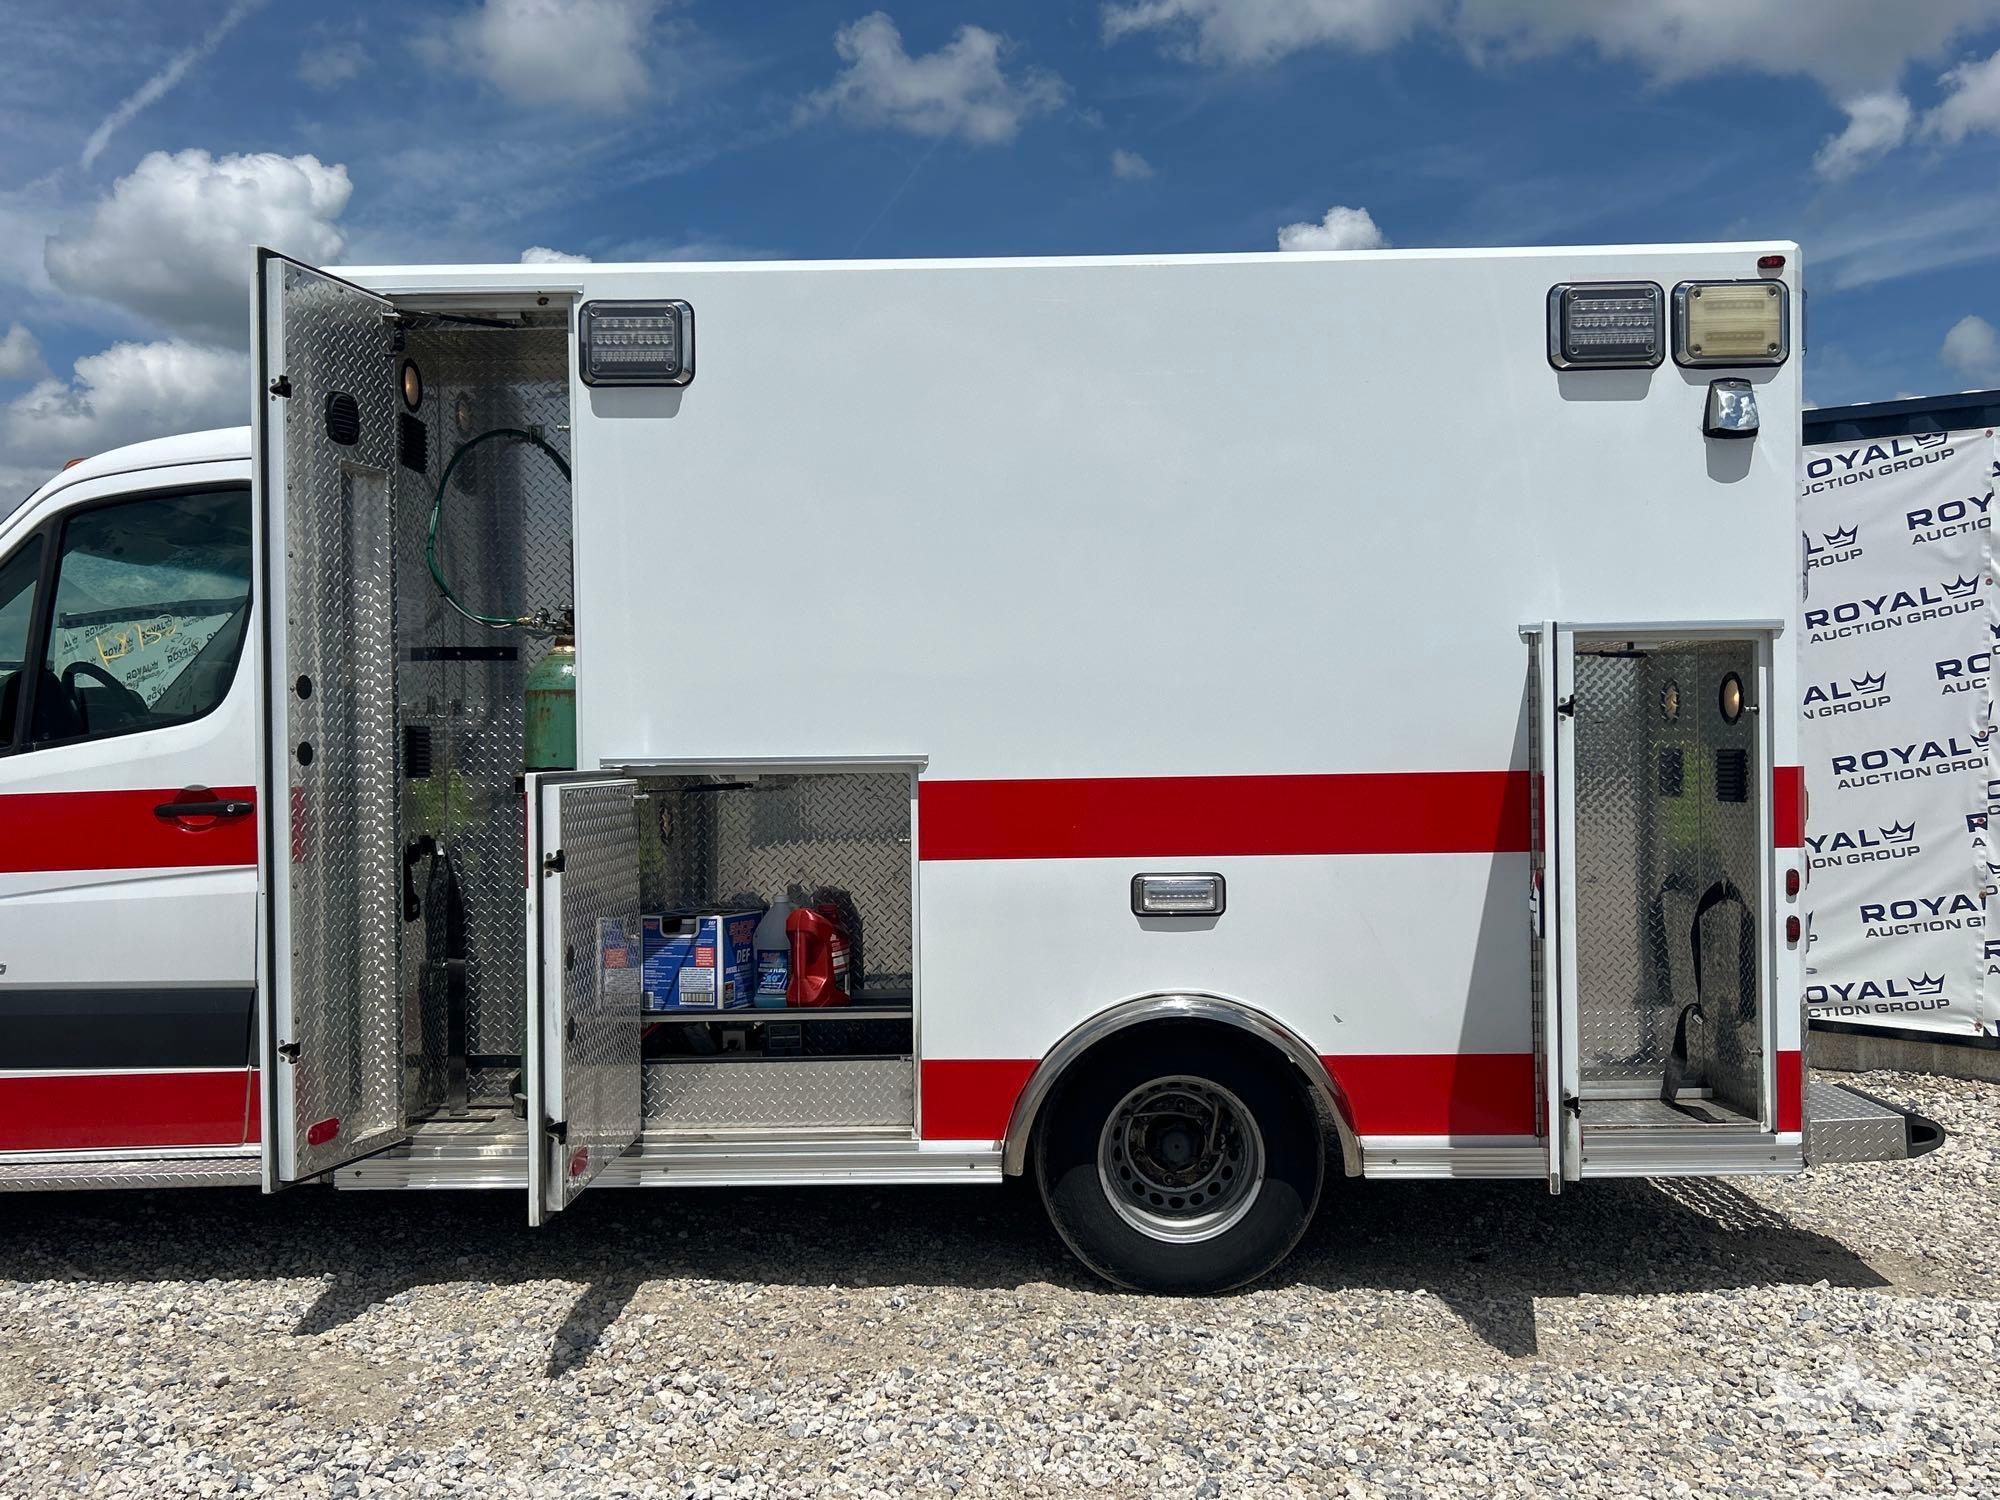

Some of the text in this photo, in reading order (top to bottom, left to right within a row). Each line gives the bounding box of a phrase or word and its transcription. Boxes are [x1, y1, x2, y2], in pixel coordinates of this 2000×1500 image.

[1806, 439, 1914, 479] OYAL
[1802, 448, 1955, 496] UCTION GROUP
[1906, 487, 1995, 531] ROY
[1911, 517, 1992, 545] AUCTIO
[1807, 548, 1864, 570] ROUP
[1804, 587, 1943, 630] ROYAL
[1810, 598, 1985, 644] AUCTION GROUP
[126, 663, 152, 680] ROYAL
[1818, 695, 1892, 718] GROUP
[1831, 737, 1972, 775] ROYAL
[1837, 757, 1989, 790] AUCTION GRO
[1804, 829, 1880, 854] YAL
[1846, 845, 1921, 865] GROUP
[1864, 918, 1962, 939] AUCTION
[736, 948, 751, 964] DEF
[1806, 979, 1910, 1004] OYAL
[1808, 998, 1951, 1018] CTION GROUP
